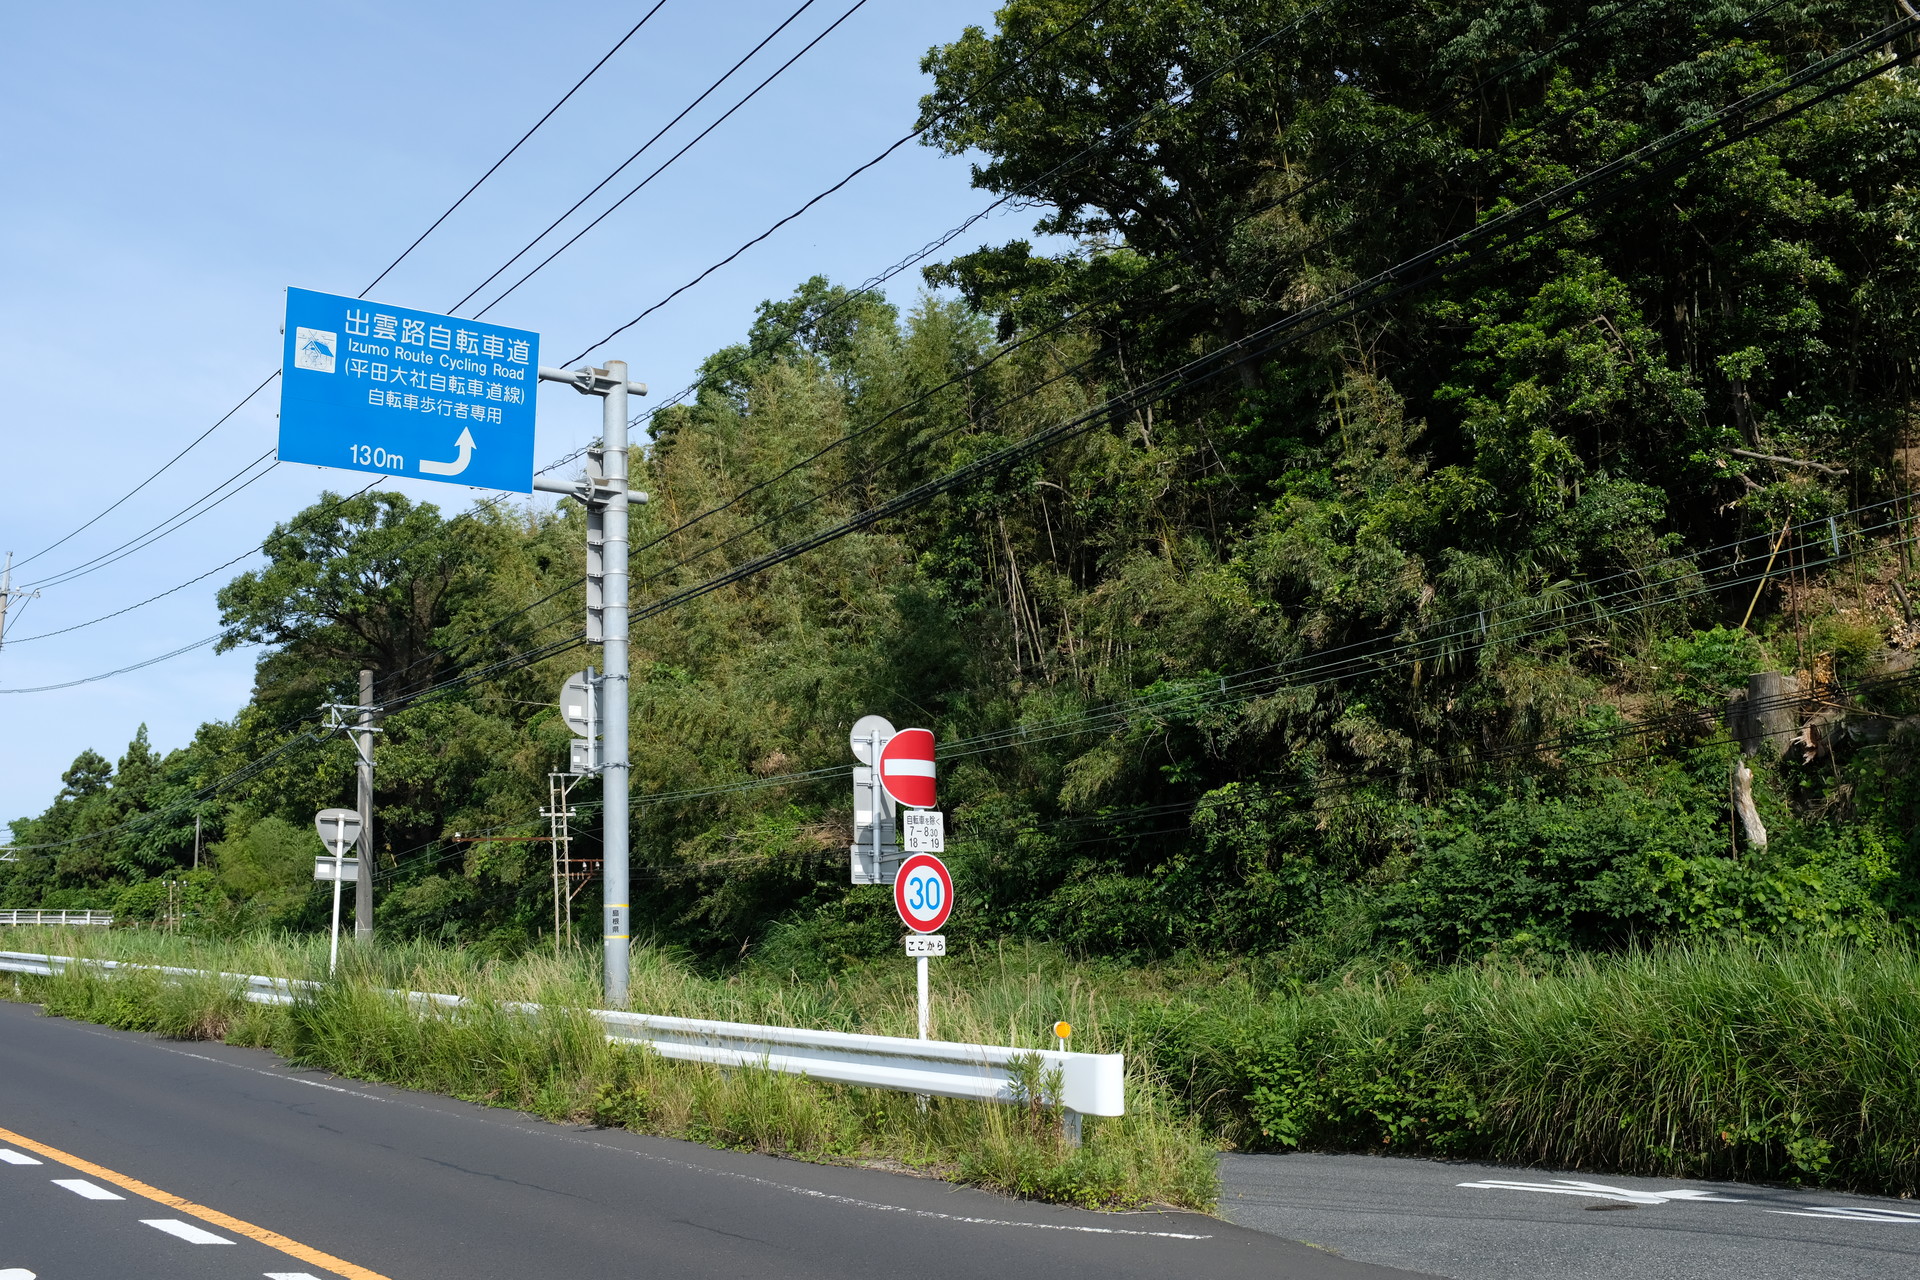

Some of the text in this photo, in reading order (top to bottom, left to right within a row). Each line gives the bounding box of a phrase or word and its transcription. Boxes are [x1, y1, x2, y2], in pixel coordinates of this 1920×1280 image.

[345, 308, 530, 365] 出雲路自転車道
[348, 338, 525, 380] Izumo Route Cycling Road
[345, 358, 525, 405] (平田大社自転車道線)
[368, 388, 502, 424] 自転車歩行者専用
[349, 444, 404, 470] 130m
[907, 815, 941, 826] 自転車を除く
[909, 877, 940, 910] 30
[908, 940, 944, 952] ここから
